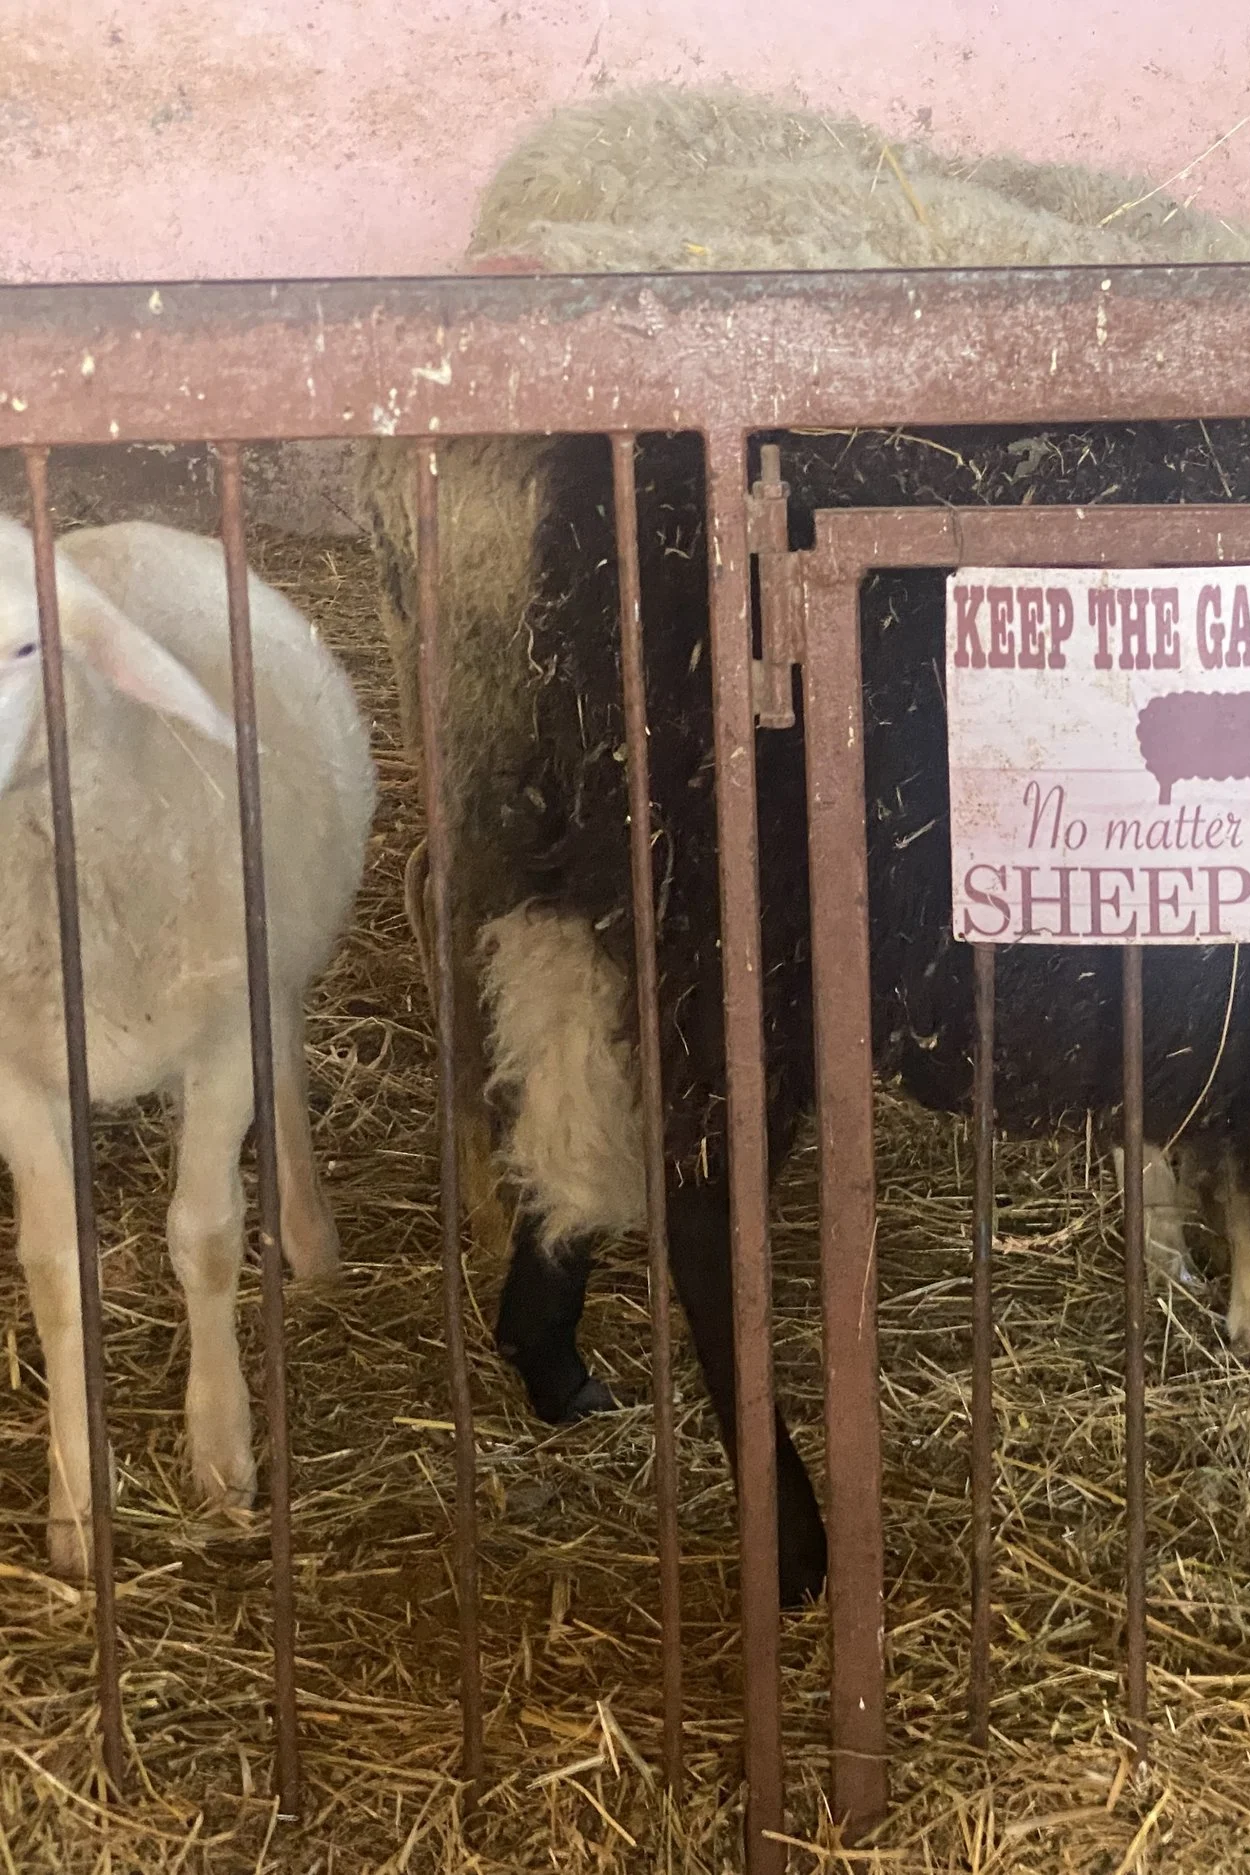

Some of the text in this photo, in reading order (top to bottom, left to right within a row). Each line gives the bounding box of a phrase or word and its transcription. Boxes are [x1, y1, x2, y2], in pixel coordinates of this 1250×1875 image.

[953, 584, 1075, 670] KEEP
[1087, 587, 1182, 670] THE
[1022, 780, 1088, 850] No
[1105, 803, 1243, 850] matter
